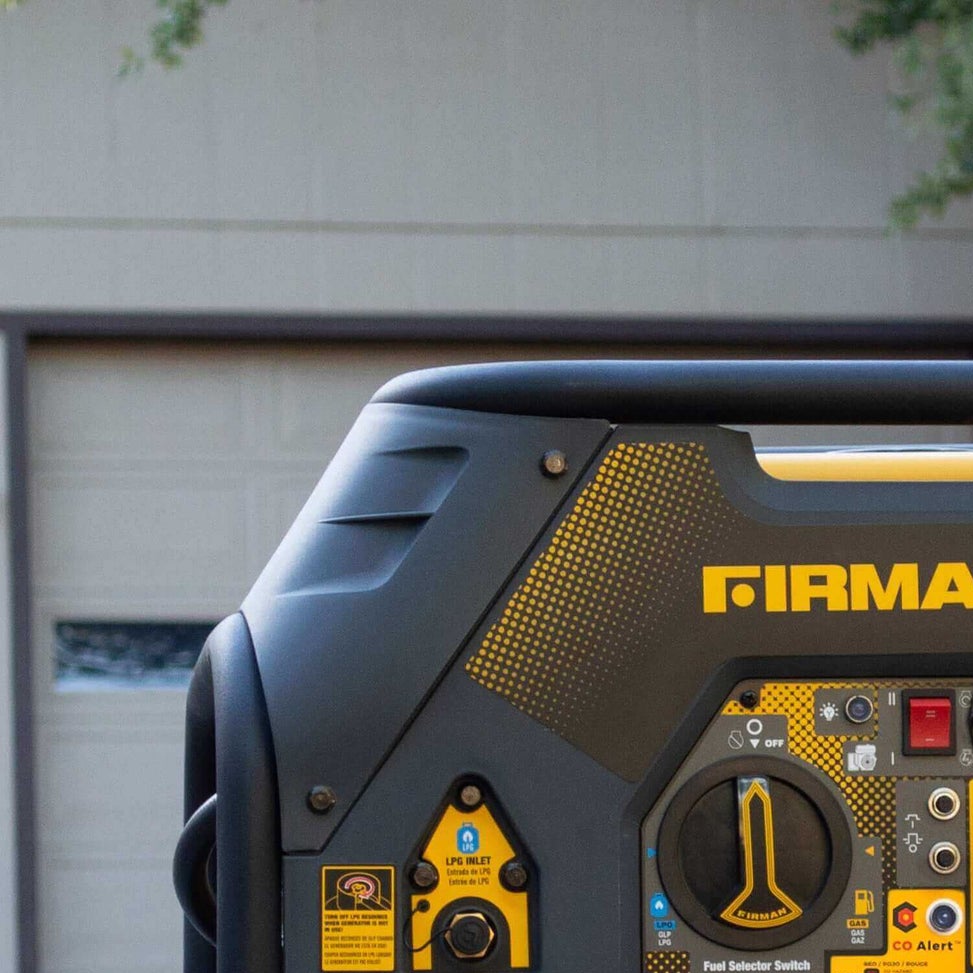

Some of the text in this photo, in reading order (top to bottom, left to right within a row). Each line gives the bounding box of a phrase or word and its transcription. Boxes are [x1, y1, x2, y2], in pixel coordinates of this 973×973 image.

[764, 739, 784, 748] OFF
[462, 843, 474, 852] LPG
[446, 856, 492, 866] LPG INLET
[737, 907, 787, 920] FIRMAN
[893, 941, 953, 951] CO Alert
[704, 960, 810, 971] Fuel Selector Switch
